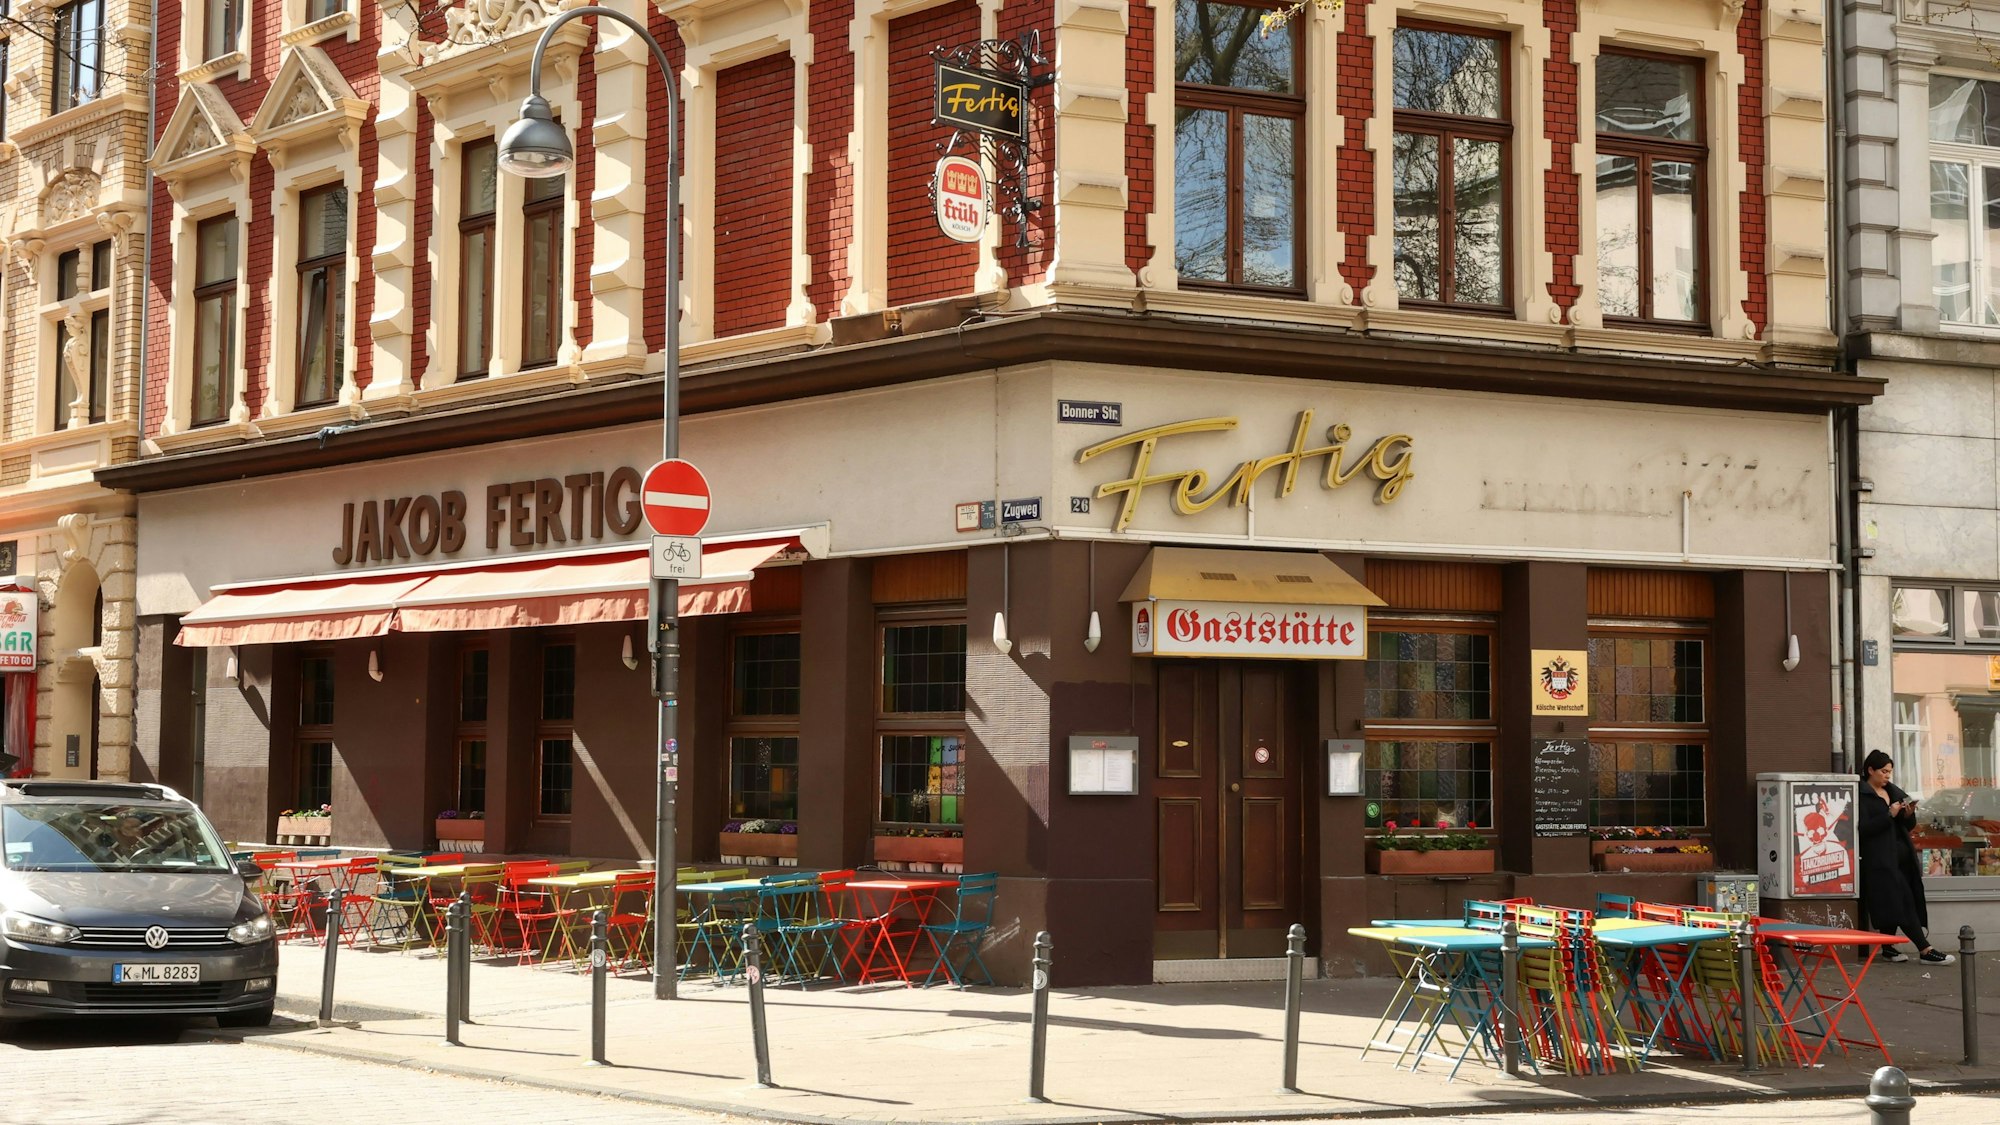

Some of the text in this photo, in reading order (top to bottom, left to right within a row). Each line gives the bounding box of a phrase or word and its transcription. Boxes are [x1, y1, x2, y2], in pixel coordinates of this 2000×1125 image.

[942, 82, 1020, 118] Fertig
[943, 197, 979, 229] früh
[1062, 403, 1119, 421] Bonner Str.
[1073, 407, 1415, 533] Fertig
[1003, 502, 1038, 519] Zugweg
[1072, 498, 1089, 512] 26
[332, 466, 645, 565] JAKOB FERTIG
[669, 563, 686, 573] frei
[1166, 607, 1356, 647] Gaststätte
[0, 631, 33, 652] AR
[0, 656, 32, 665] FE TO GO
[1540, 740, 1576, 755] Fertig
[1794, 790, 1852, 805] KASALLA
[123, 966, 198, 980] K ML 8283
